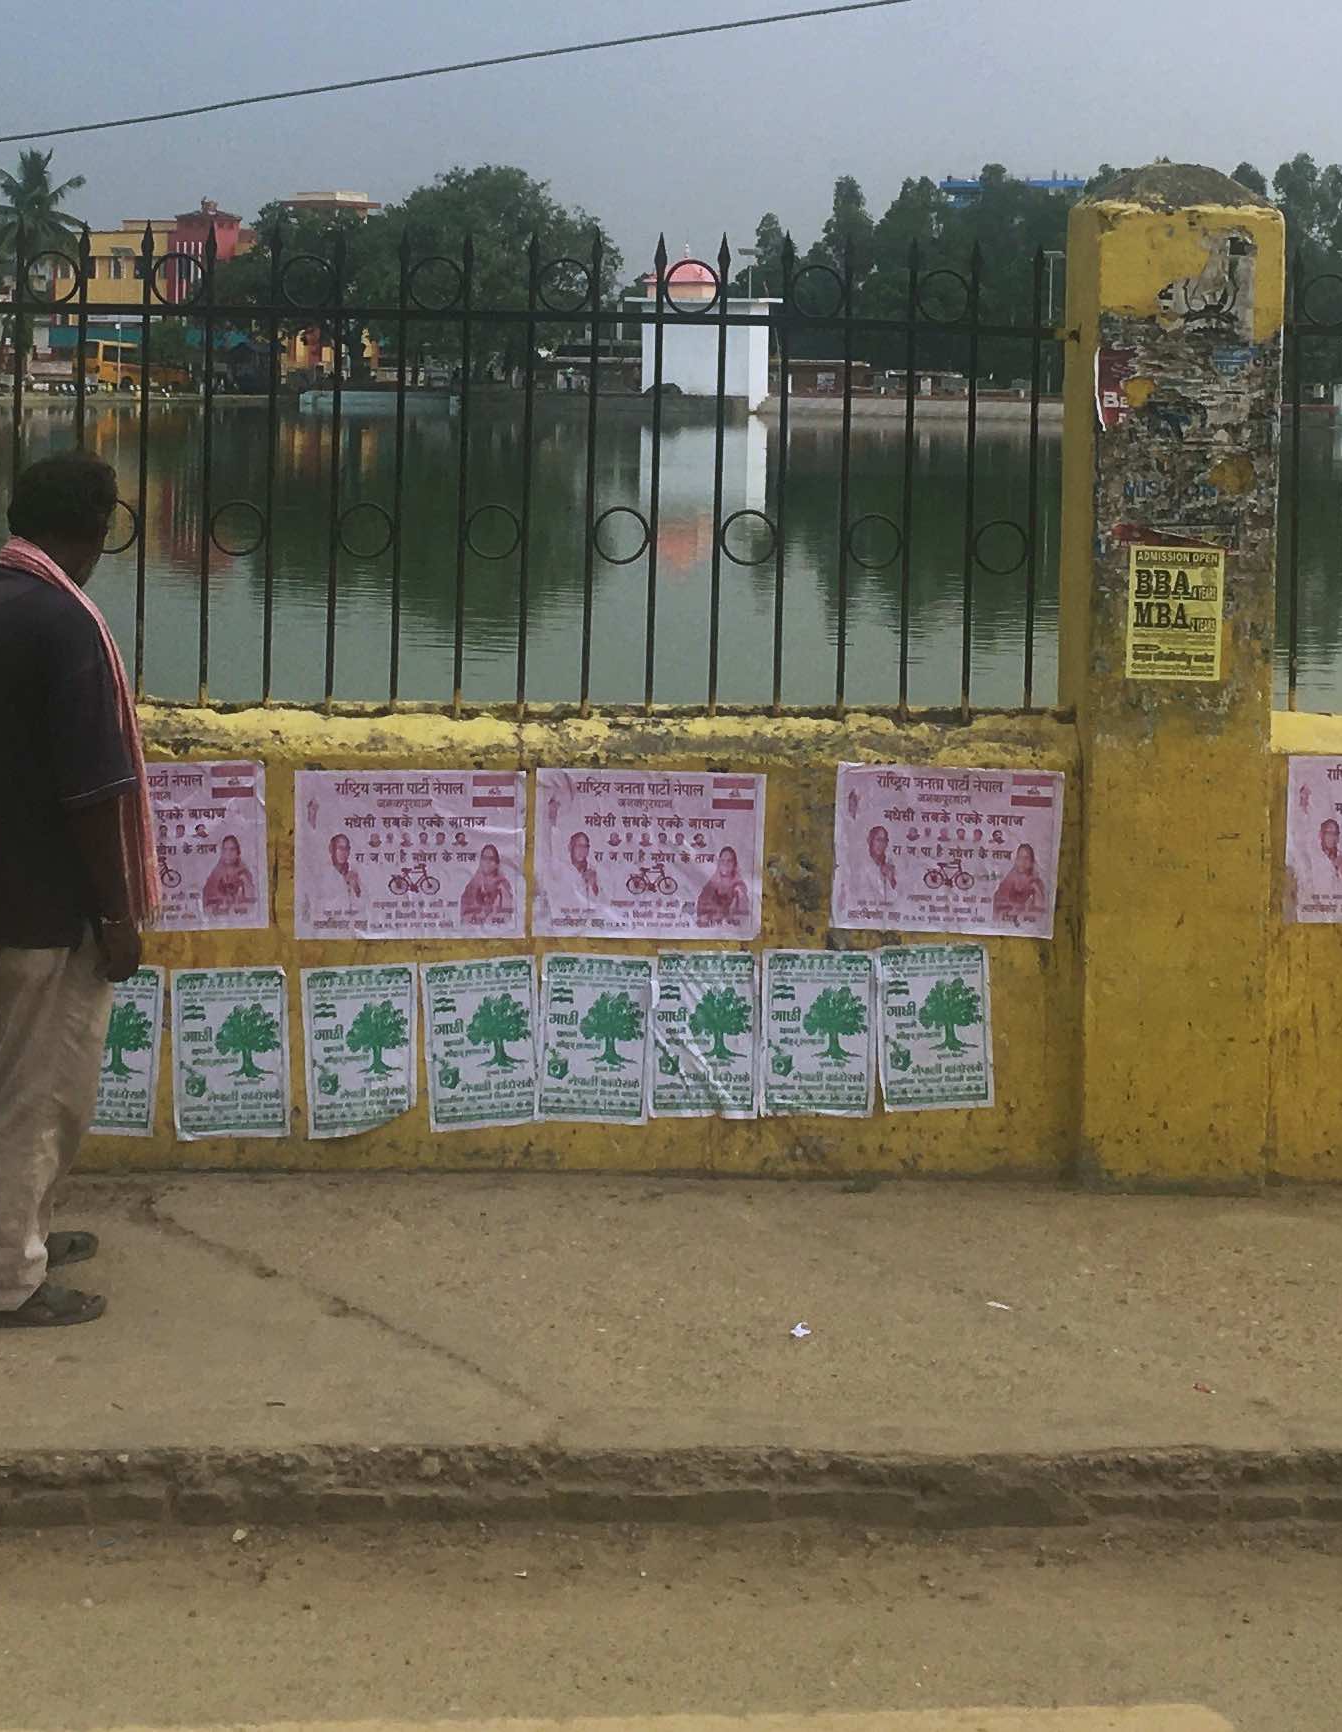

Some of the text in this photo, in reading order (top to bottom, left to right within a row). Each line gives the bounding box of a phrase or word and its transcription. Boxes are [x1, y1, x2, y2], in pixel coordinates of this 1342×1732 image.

[1138, 551, 1218, 562] ADMISSION OPEN
[1135, 569, 1192, 600] BBA
[1133, 602, 1190, 629] MBA
